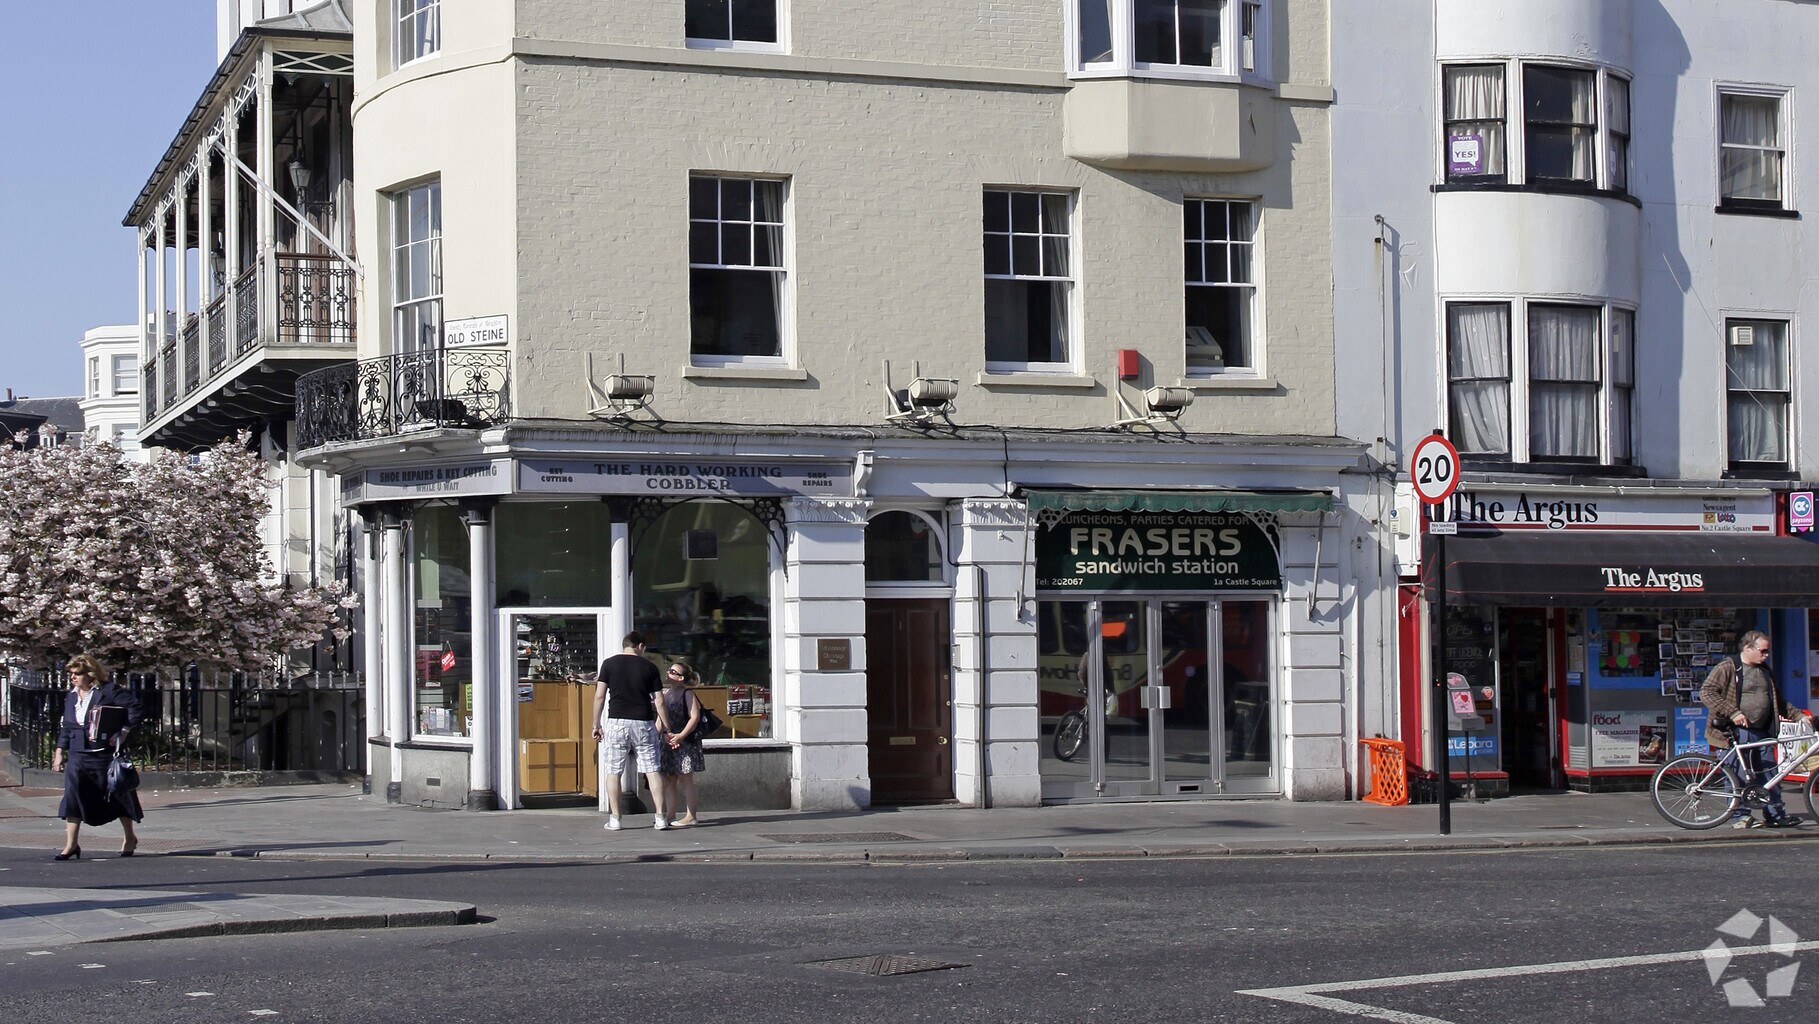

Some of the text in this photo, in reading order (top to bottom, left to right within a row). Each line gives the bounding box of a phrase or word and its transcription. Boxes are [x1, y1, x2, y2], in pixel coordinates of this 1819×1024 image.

[448, 328, 504, 344] OLD STEINE
[379, 465, 498, 483] SHOE REPAIRS & KEY CUTTING
[593, 463, 782, 479] THE HARD WORKING
[1418, 454, 1451, 484] 20
[416, 481, 460, 493] WHILE U WAIT
[646, 478, 732, 490] COBBLER
[802, 479, 833, 487] REPAIRS
[1451, 491, 1599, 529] The Argus
[1703, 503, 1737, 512] Newsagent
[1060, 515, 1250, 525] LUNCHEONS, PARTIES CATERED FOR
[1732, 525, 1751, 533] Square
[1070, 528, 1242, 556] FRASERS
[1075, 557, 1239, 574] sandwich station
[1052, 578, 1084, 586] 202067
[1213, 578, 1277, 587] 1a Castle Square
[1601, 567, 1704, 592] The Argus
[1593, 714, 1621, 725] food
